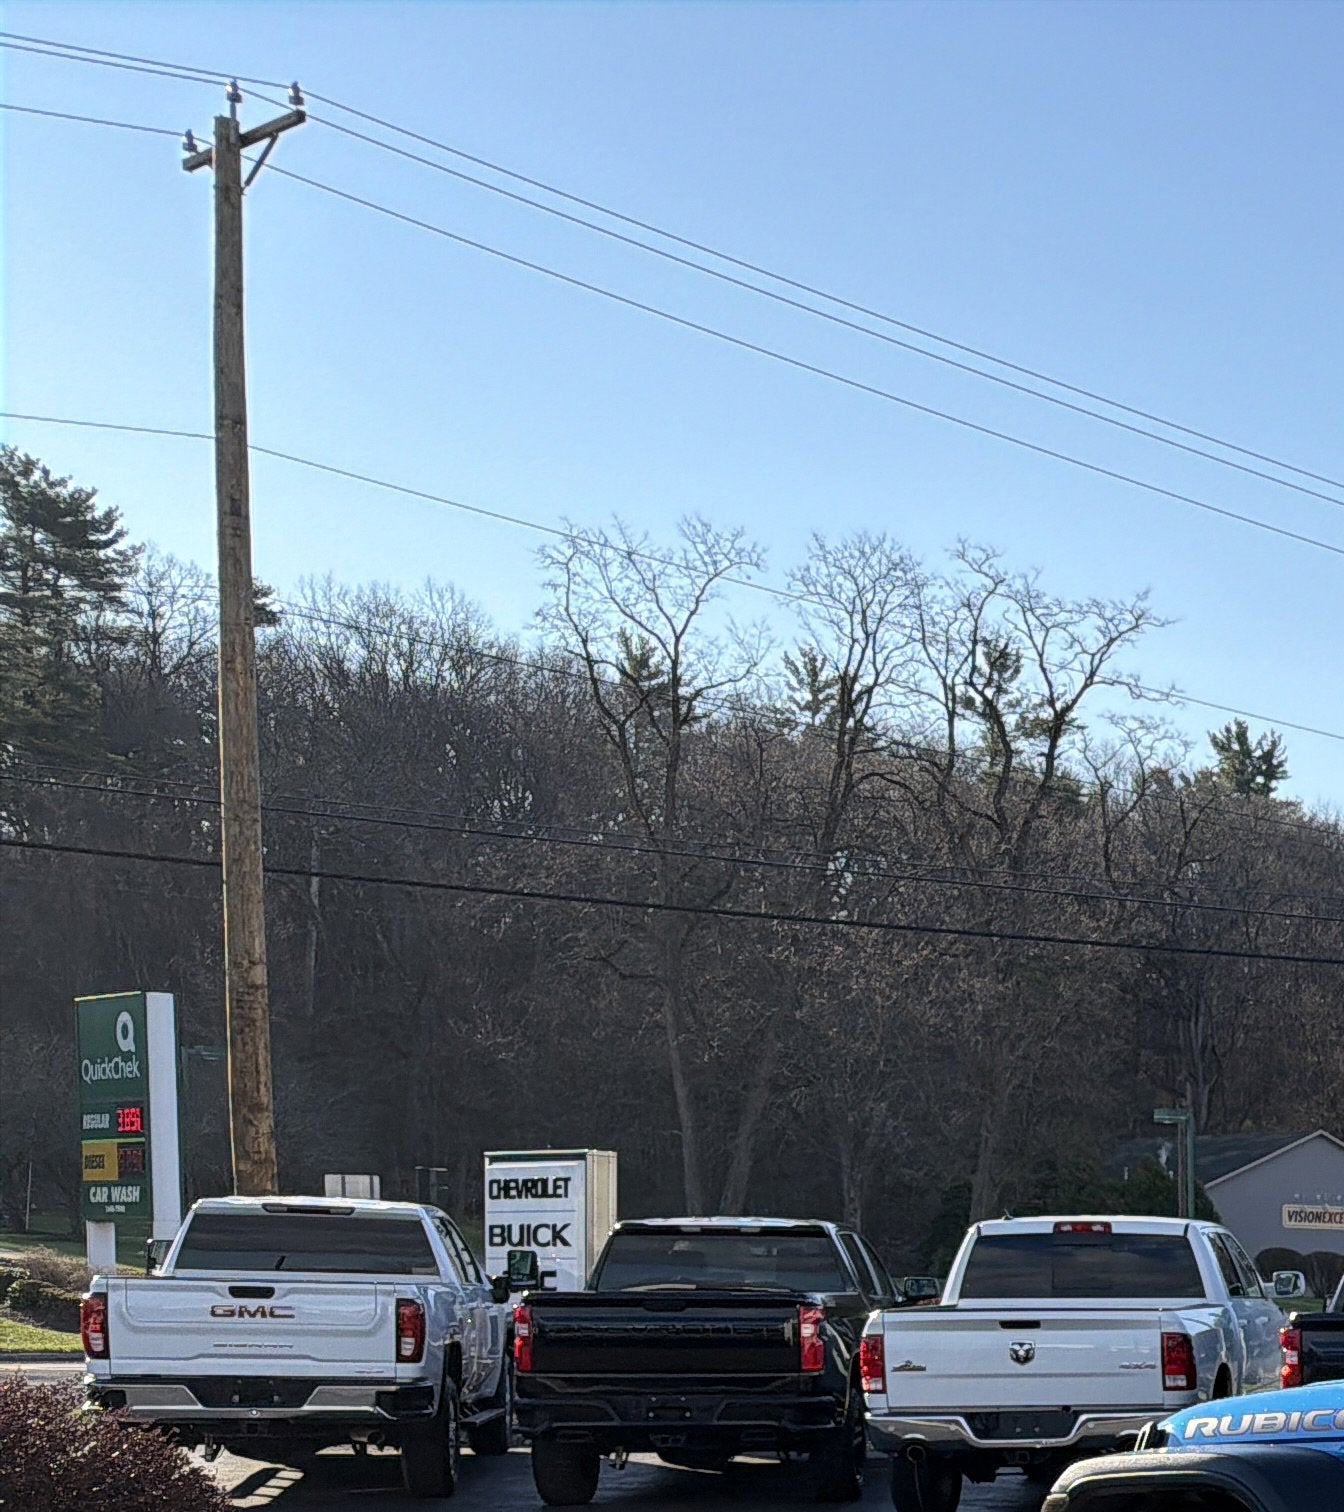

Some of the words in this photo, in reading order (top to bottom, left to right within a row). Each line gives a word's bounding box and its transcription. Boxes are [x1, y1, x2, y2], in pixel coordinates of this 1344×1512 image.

[81, 1054, 141, 1085] QuickChek
[89, 1186, 109, 1203] CAR
[110, 1185, 141, 1203] WASH
[488, 1176, 572, 1201] CHEVROLET
[488, 1222, 572, 1248] BUICK
[209, 1304, 296, 1319] GMC
